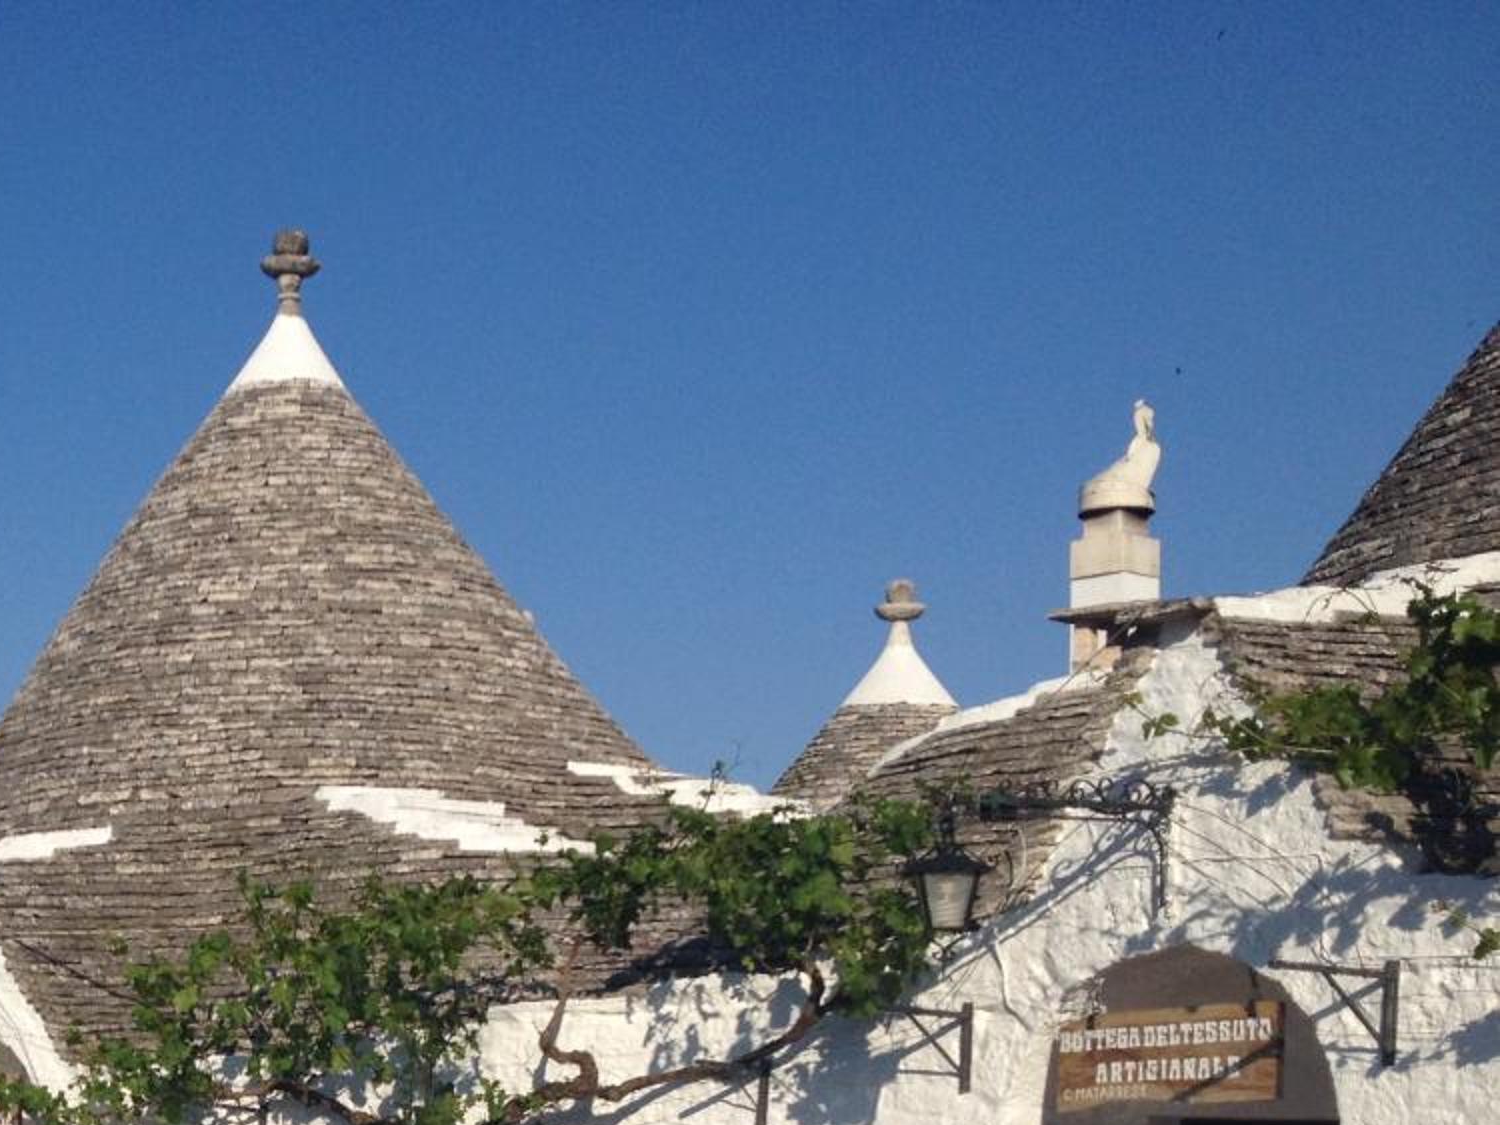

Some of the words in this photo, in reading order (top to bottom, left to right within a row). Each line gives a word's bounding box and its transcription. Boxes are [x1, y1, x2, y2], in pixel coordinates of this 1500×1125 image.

[1060, 1026, 1141, 1053] BOTTEGA
[1143, 1022, 1183, 1047] DEL
[1182, 1017, 1273, 1044] TESSUTO
[1095, 1055, 1241, 1084] ARTIGIANALE
